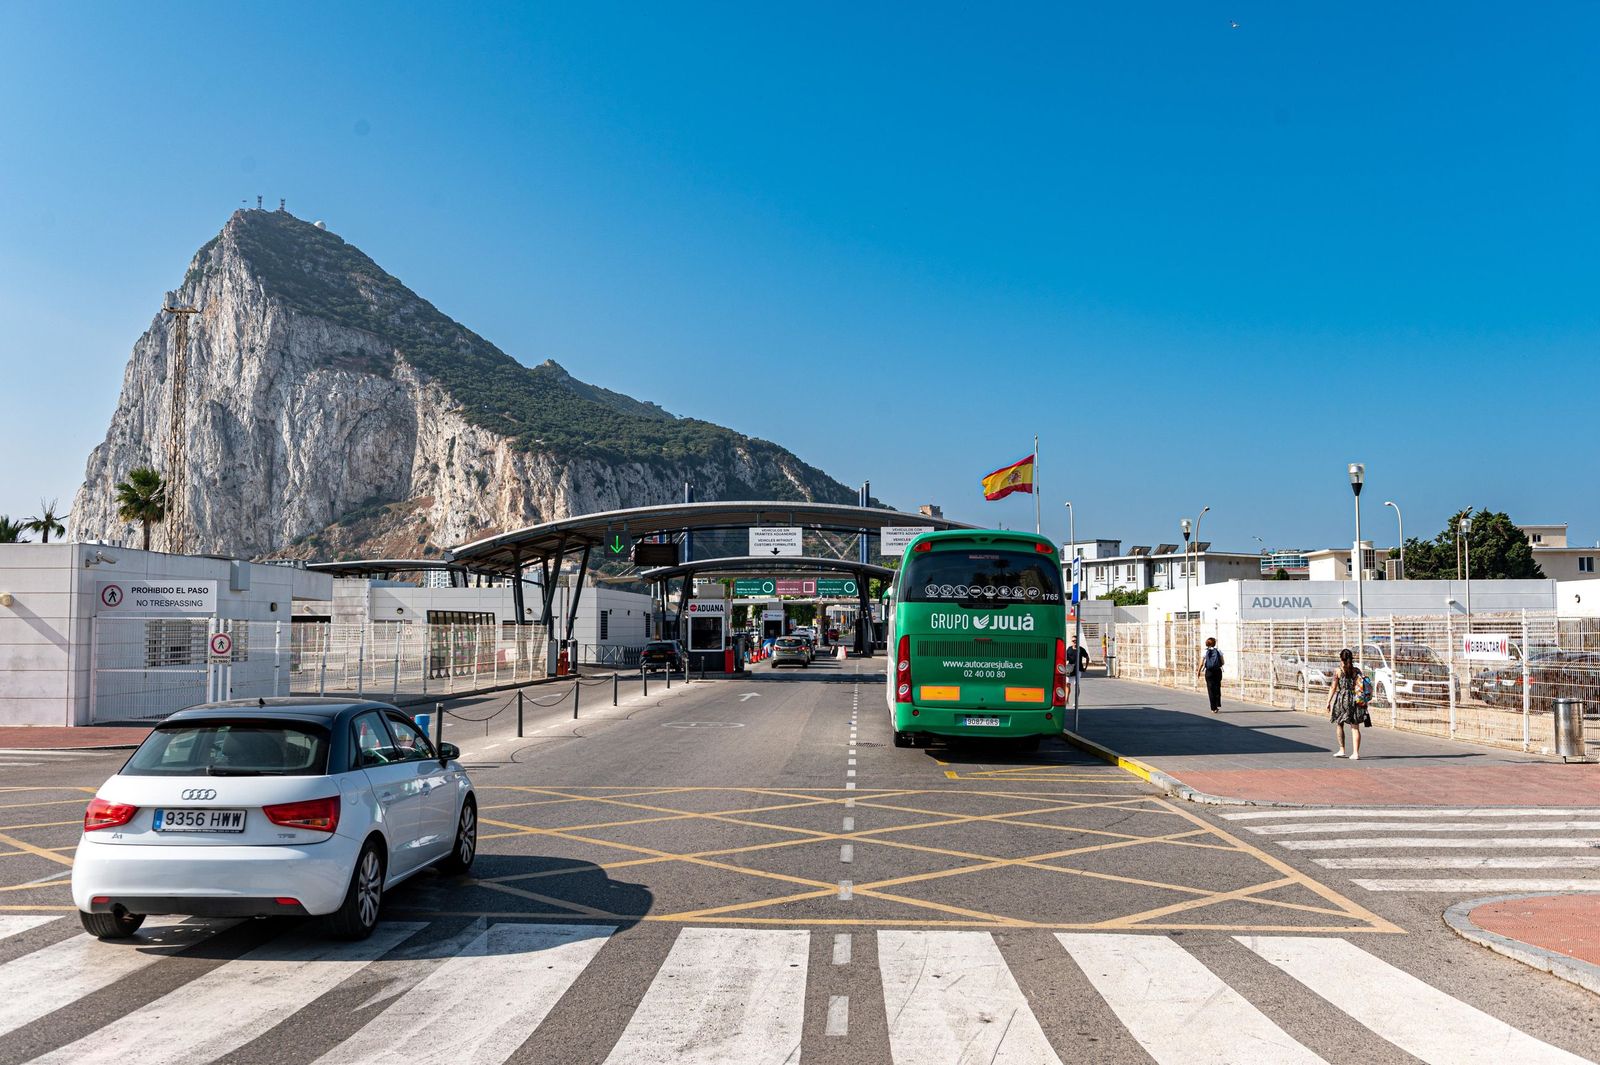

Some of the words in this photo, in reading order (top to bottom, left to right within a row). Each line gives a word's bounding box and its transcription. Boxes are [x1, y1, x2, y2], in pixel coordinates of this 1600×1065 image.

[697, 604, 724, 612] ADUANA
[1252, 597, 1313, 608] ADUANA
[931, 613, 969, 630] GRUPO
[1471, 641, 1500, 652] GIBRALTAR
[942, 660, 1024, 670] www.autocaresjulia.es
[963, 670, 973, 678] 02
[975, 670, 984, 678] 40
[985, 670, 995, 678] 00
[165, 811, 206, 826] 9356
[210, 812, 242, 827] HWW
